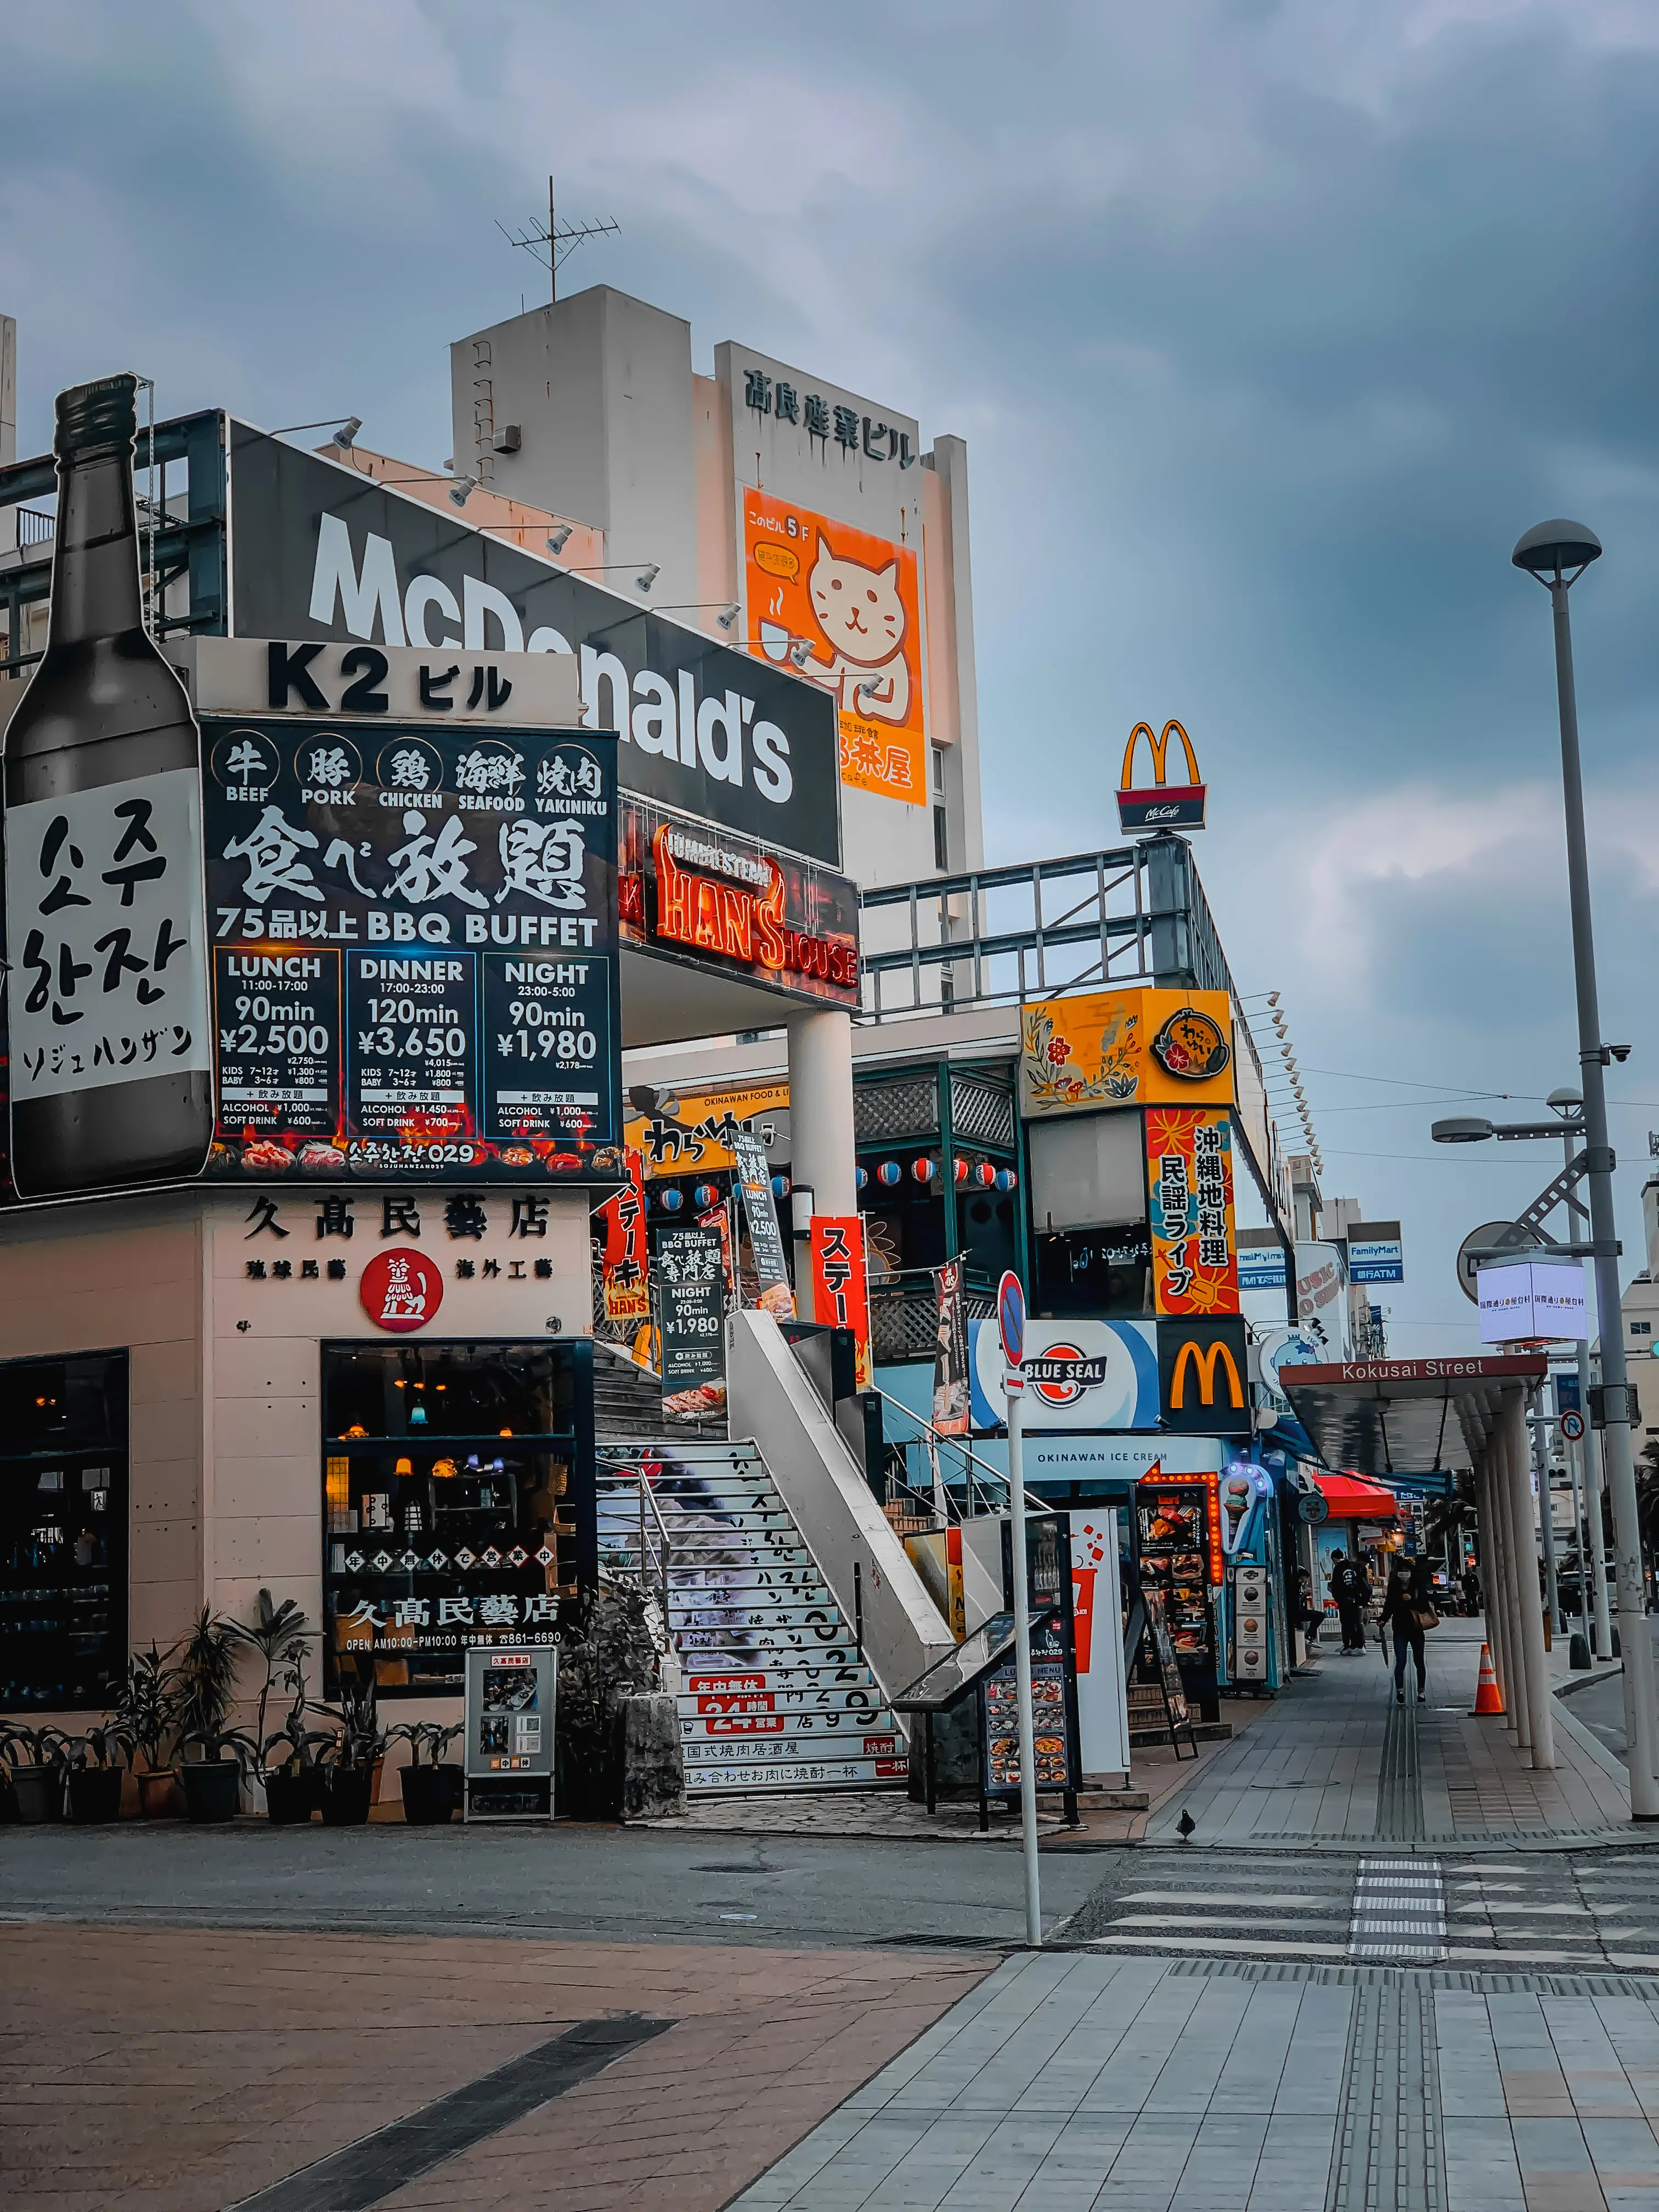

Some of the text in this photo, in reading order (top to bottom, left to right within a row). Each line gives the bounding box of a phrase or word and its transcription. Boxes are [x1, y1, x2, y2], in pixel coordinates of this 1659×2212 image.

[267, 642, 513, 713] K2 ビル
[225, 741, 603, 797] 牛 豚 鶏 海鮮 焼肉
[226, 787, 607, 816] BEEF PORK CHICKEN SEAFOOD YAKINIKU
[37, 797, 168, 917] 소주
[222, 804, 587, 910] 食べ放題
[216, 907, 599, 947] 75品以上 BBQ BUFFET
[780, 927, 859, 988] HOUSE
[21, 918, 188, 1026] 한잔
[228, 956, 320, 978] LUNCH
[360, 959, 464, 981] DINNER
[505, 962, 589, 985] NIGHT
[241, 980, 308, 991] 11:00-17:00
[380, 983, 445, 995] 17:00-23:00
[517, 986, 575, 997] 23:00-5:00
[235, 996, 315, 1022] 90min
[367, 998, 459, 1024] 120min
[509, 1001, 585, 1027] 90min
[221, 1024, 329, 1056] ¥2,500
[358, 1026, 466, 1058] ¥3,650
[498, 1029, 596, 1062] ¥1,980
[22, 1024, 193, 1081] ソジュハンザン
[287, 1057, 313, 1065] ¥2,750
[222, 1066, 243, 1075] KIDS
[287, 1068, 314, 1076] ¥1,300
[425, 1059, 451, 1068] ¥4,015
[222, 1076, 243, 1085] BABY
[295, 1076, 315, 1085] ¥800
[361, 1068, 382, 1077] KIDS
[425, 1070, 451, 1078] ¥1,800
[361, 1078, 382, 1087] BABY
[432, 1079, 451, 1087] ¥800
[222, 1103, 310, 1113] ALCOHOL ¥1,000
[704, 1093, 748, 1107] OKINAWAN
[750, 1091, 773, 1101] FOOD
[360, 1105, 407, 1114] ALCOHOL
[415, 1104, 447, 1114] ¥1,450
[497, 1106, 582, 1116] ALCOHOL ¥1,000
[223, 1116, 246, 1125] SOFT
[248, 1116, 278, 1125] DRINK
[287, 1116, 311, 1126] ¥600
[362, 1118, 385, 1127] SOFT
[387, 1118, 415, 1127] DRINK
[425, 1118, 448, 1127] ¥700
[499, 1119, 521, 1128] SOFT
[523, 1119, 550, 1128] DRINK
[560, 1119, 583, 1128] ¥600
[746, 1189, 768, 1201] LUNCH
[1192, 1126, 1229, 1268] 沖縄地料理
[749, 1218, 777, 1236] ¥2,500
[1159, 1154, 1193, 1297] 民謡ライブ
[662, 1239, 717, 1249] BBQ BUFFET
[1351, 1245, 1399, 1256] FamilyMart
[658, 1248, 721, 1267] 食べ放題
[664, 1265, 716, 1283] 専門店
[820, 1227, 852, 1330] ステー
[671, 1286, 711, 1299] NIGHT
[675, 1305, 708, 1317] 90min
[665, 1317, 719, 1335] ¥1,980
[1025, 1363, 1102, 1379] BLUE SEAL
[1342, 1359, 1483, 1379] Kokusai Street
[1037, 1452, 1168, 1463] OKINAWAN ICE CREAM
[346, 1639, 371, 1651] OPEN
[374, 1635, 457, 1649] AM10:00-PM10:00
[460, 1633, 493, 1646] 年中無休
[1037, 1666, 1061, 1674] MENU
[705, 1701, 768, 1730] 24 時間
[681, 1742, 799, 1759] 国式焼肉居酒屋
[865, 1742, 895, 1754] 焼酎
